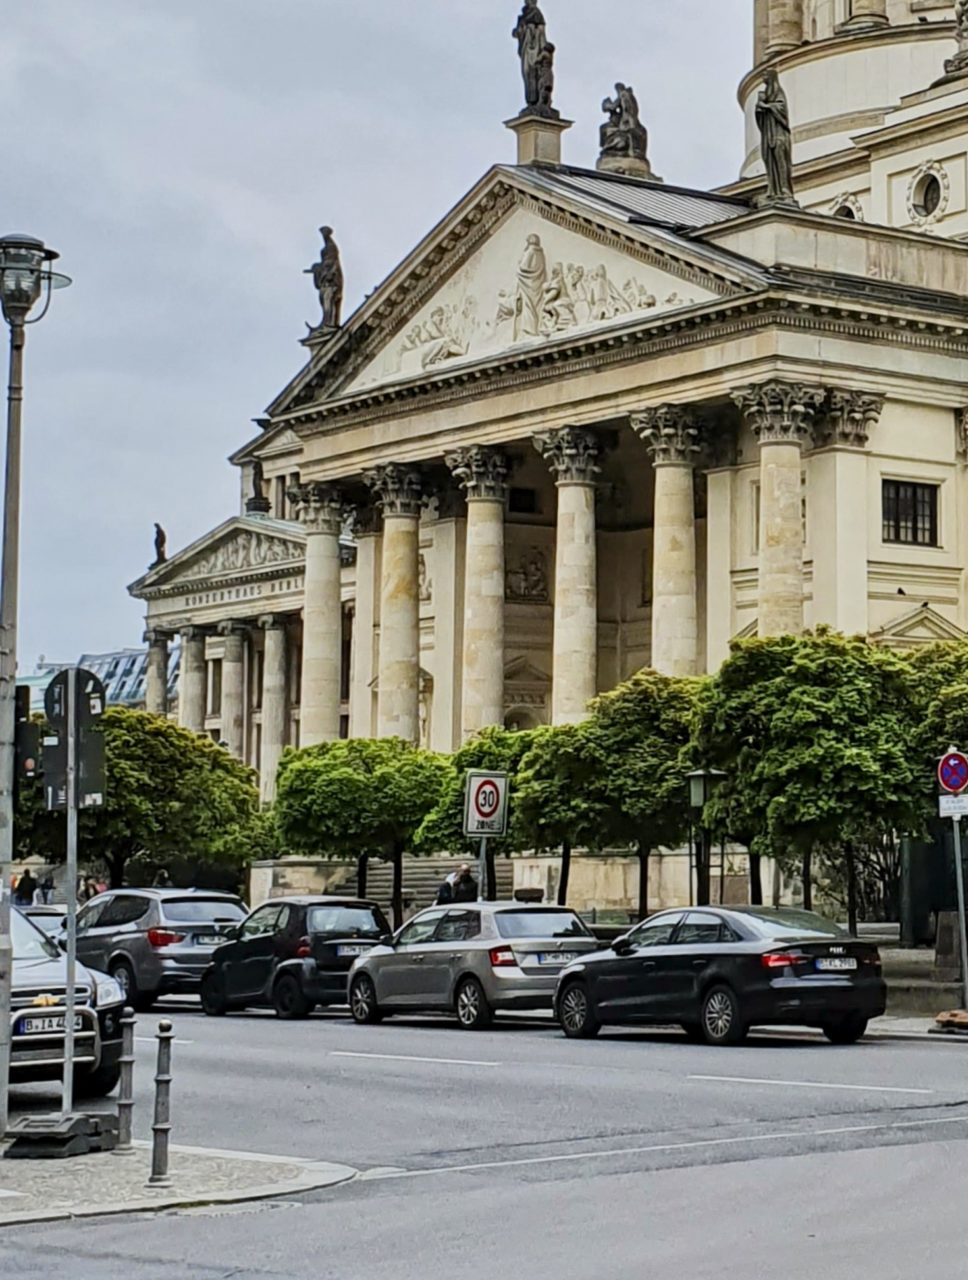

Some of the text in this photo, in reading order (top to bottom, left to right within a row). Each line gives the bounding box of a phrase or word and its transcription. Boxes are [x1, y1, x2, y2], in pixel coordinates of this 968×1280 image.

[185, 577, 305, 607] KONZERTHAUS BERLI
[480, 790, 495, 808] 30
[476, 820, 497, 830] ZONE
